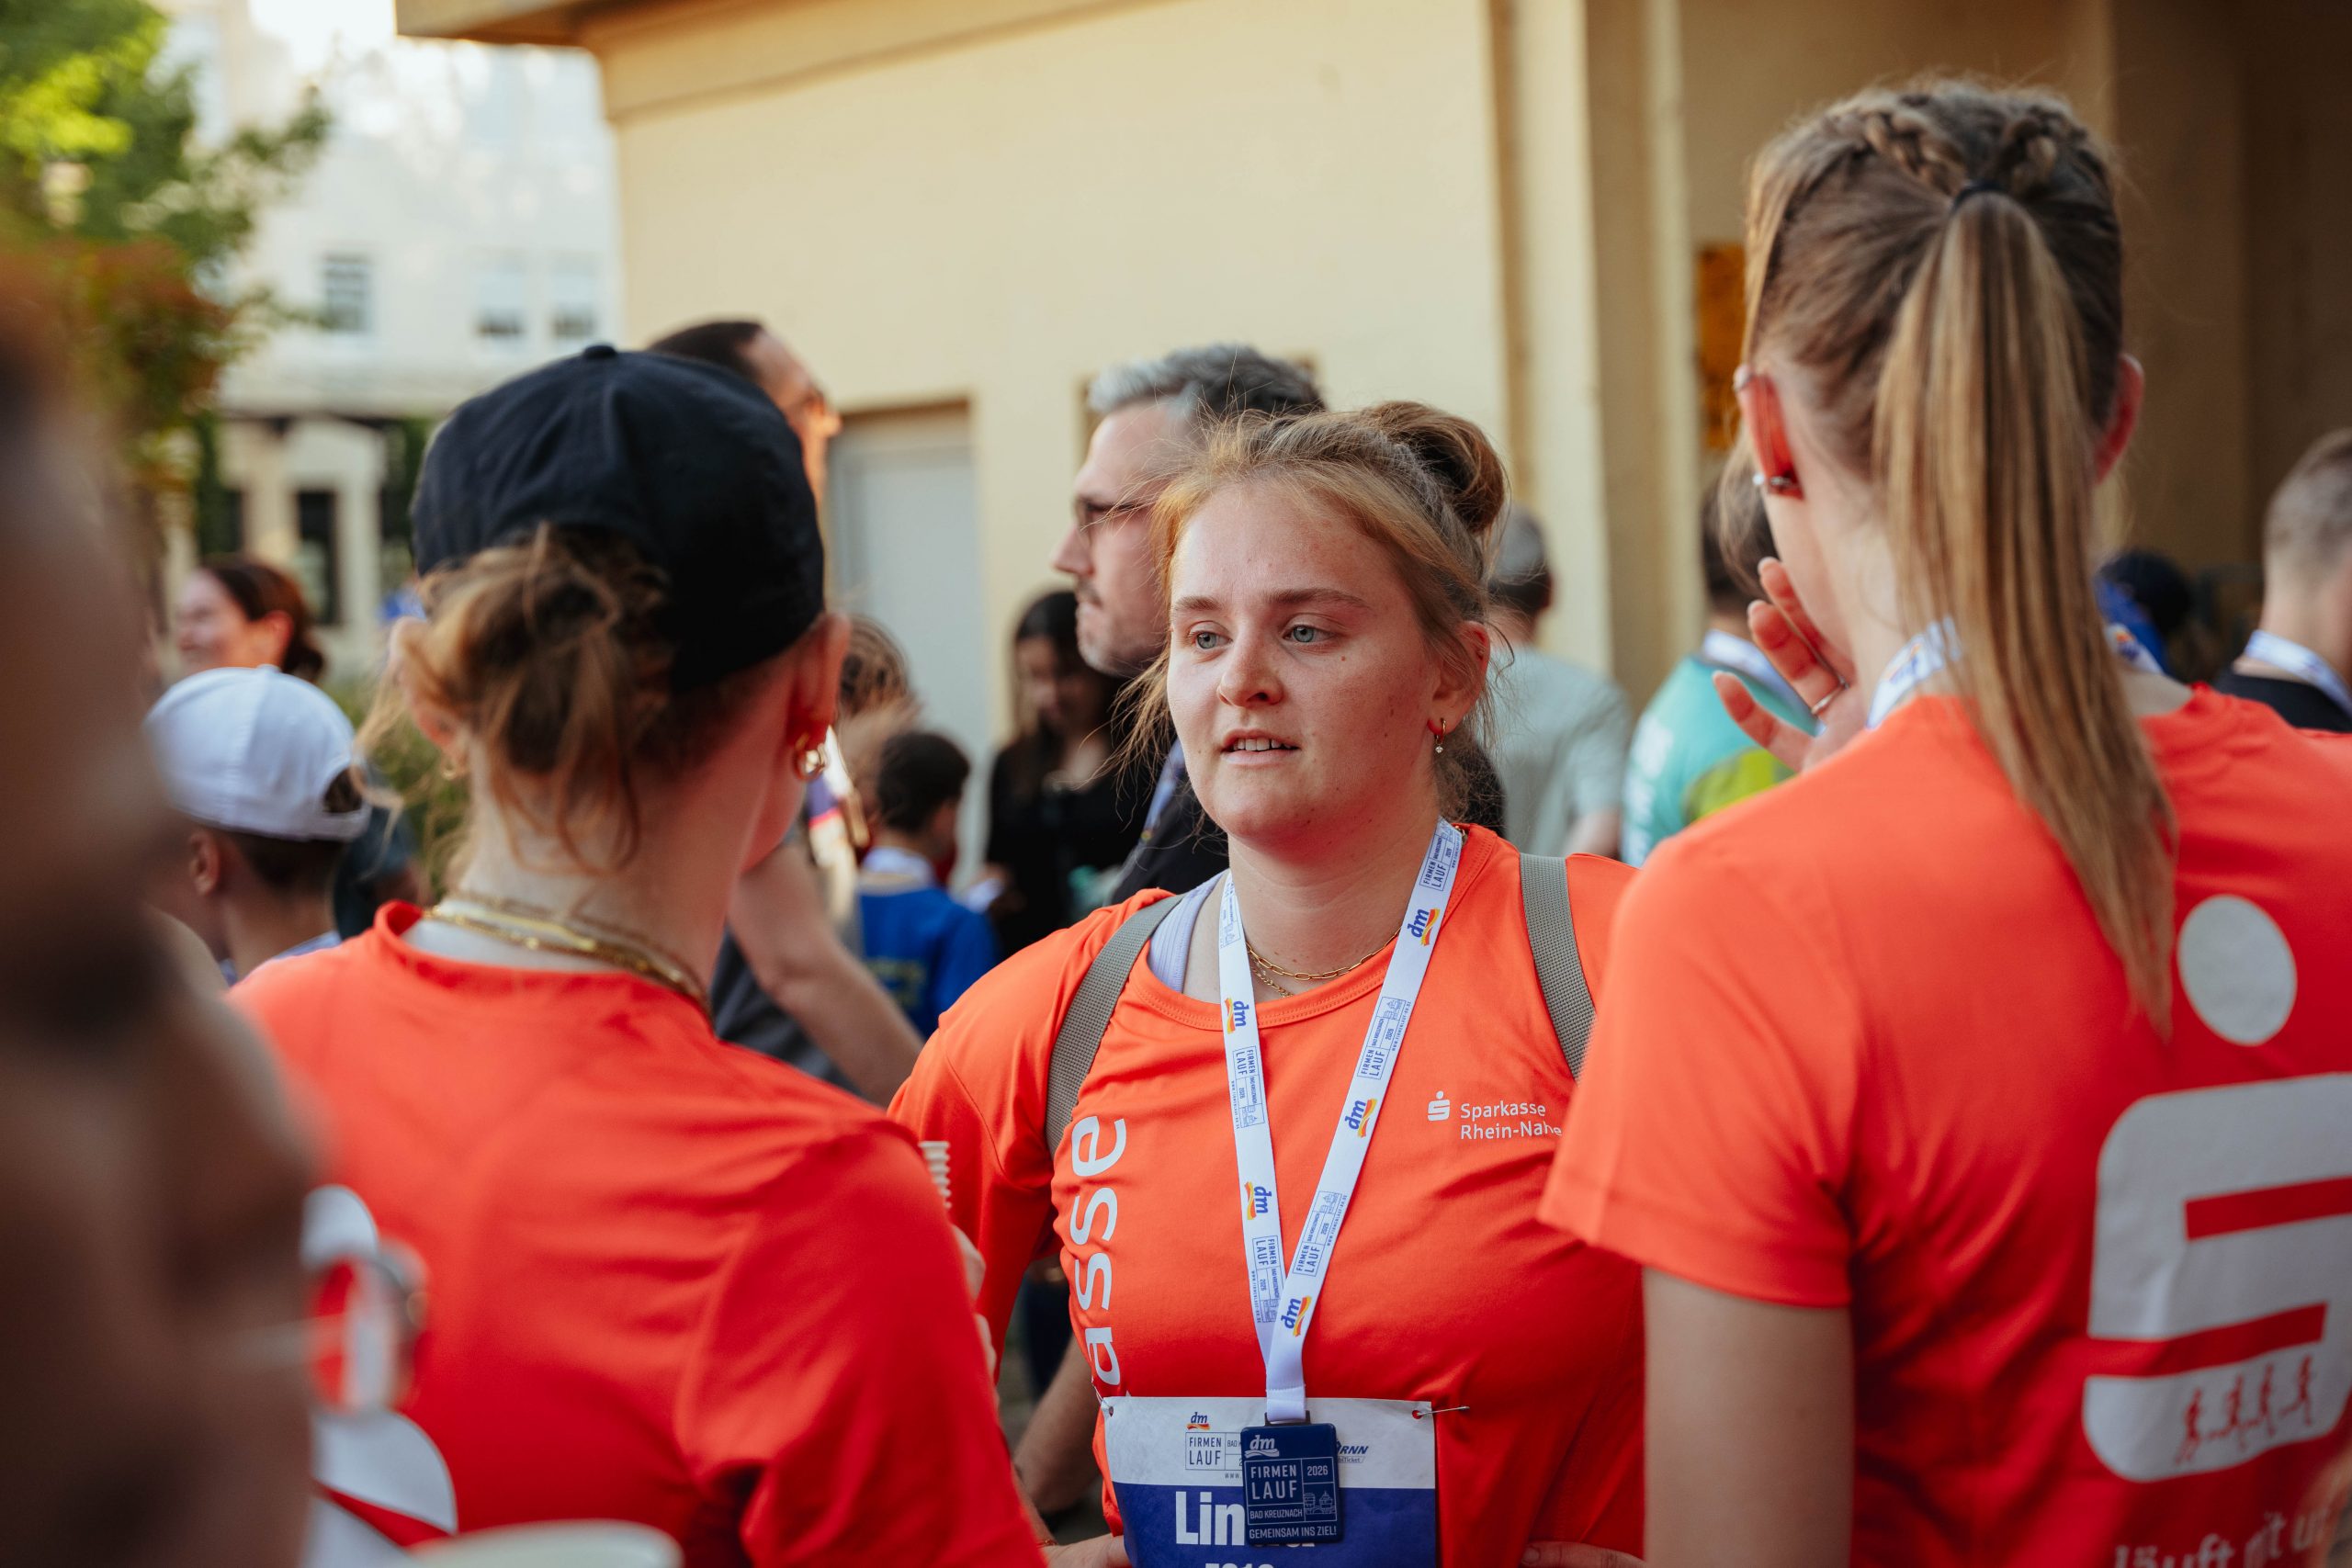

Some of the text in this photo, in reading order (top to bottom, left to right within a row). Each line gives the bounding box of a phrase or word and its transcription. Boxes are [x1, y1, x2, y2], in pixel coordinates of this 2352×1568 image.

[1423, 861, 1436, 884] FIRMEN
[1432, 864, 1446, 887] LAUF
[1407, 908, 1430, 939] dm
[1233, 1000, 1250, 1027] dm
[1236, 1052, 1247, 1075] LAUF
[1247, 1050, 1256, 1073] FIRMEN
[1362, 1049, 1374, 1074] FIRMEN
[1370, 1051, 1385, 1076] LAUF
[1345, 1100, 1366, 1130] dm
[1461, 1100, 1546, 1122] Sparkasse
[1461, 1121, 1562, 1139] Rhein-Nahe
[1254, 1186, 1272, 1213] dm
[1256, 1240, 1269, 1266] LAUF
[1268, 1238, 1277, 1264] FIRMEN
[1296, 1246, 1309, 1270] FIRMEN
[1305, 1247, 1319, 1272] LAUF
[1281, 1298, 1301, 1329] dm
[1191, 1412, 1207, 1423] dm
[1190, 1438, 1221, 1447] FIRMEN
[1250, 1435, 1275, 1450] dm
[1190, 1450, 1221, 1465] LAUF
[1250, 1464, 1297, 1479] FIRMEN
[1307, 1465, 1329, 1476] 2026
[1251, 1480, 1297, 1499] LAUF
[1250, 1508, 1303, 1519] BAD KREUZNACH
[1250, 1526, 1337, 1539] GEMEINSAM INS ZIEL!
